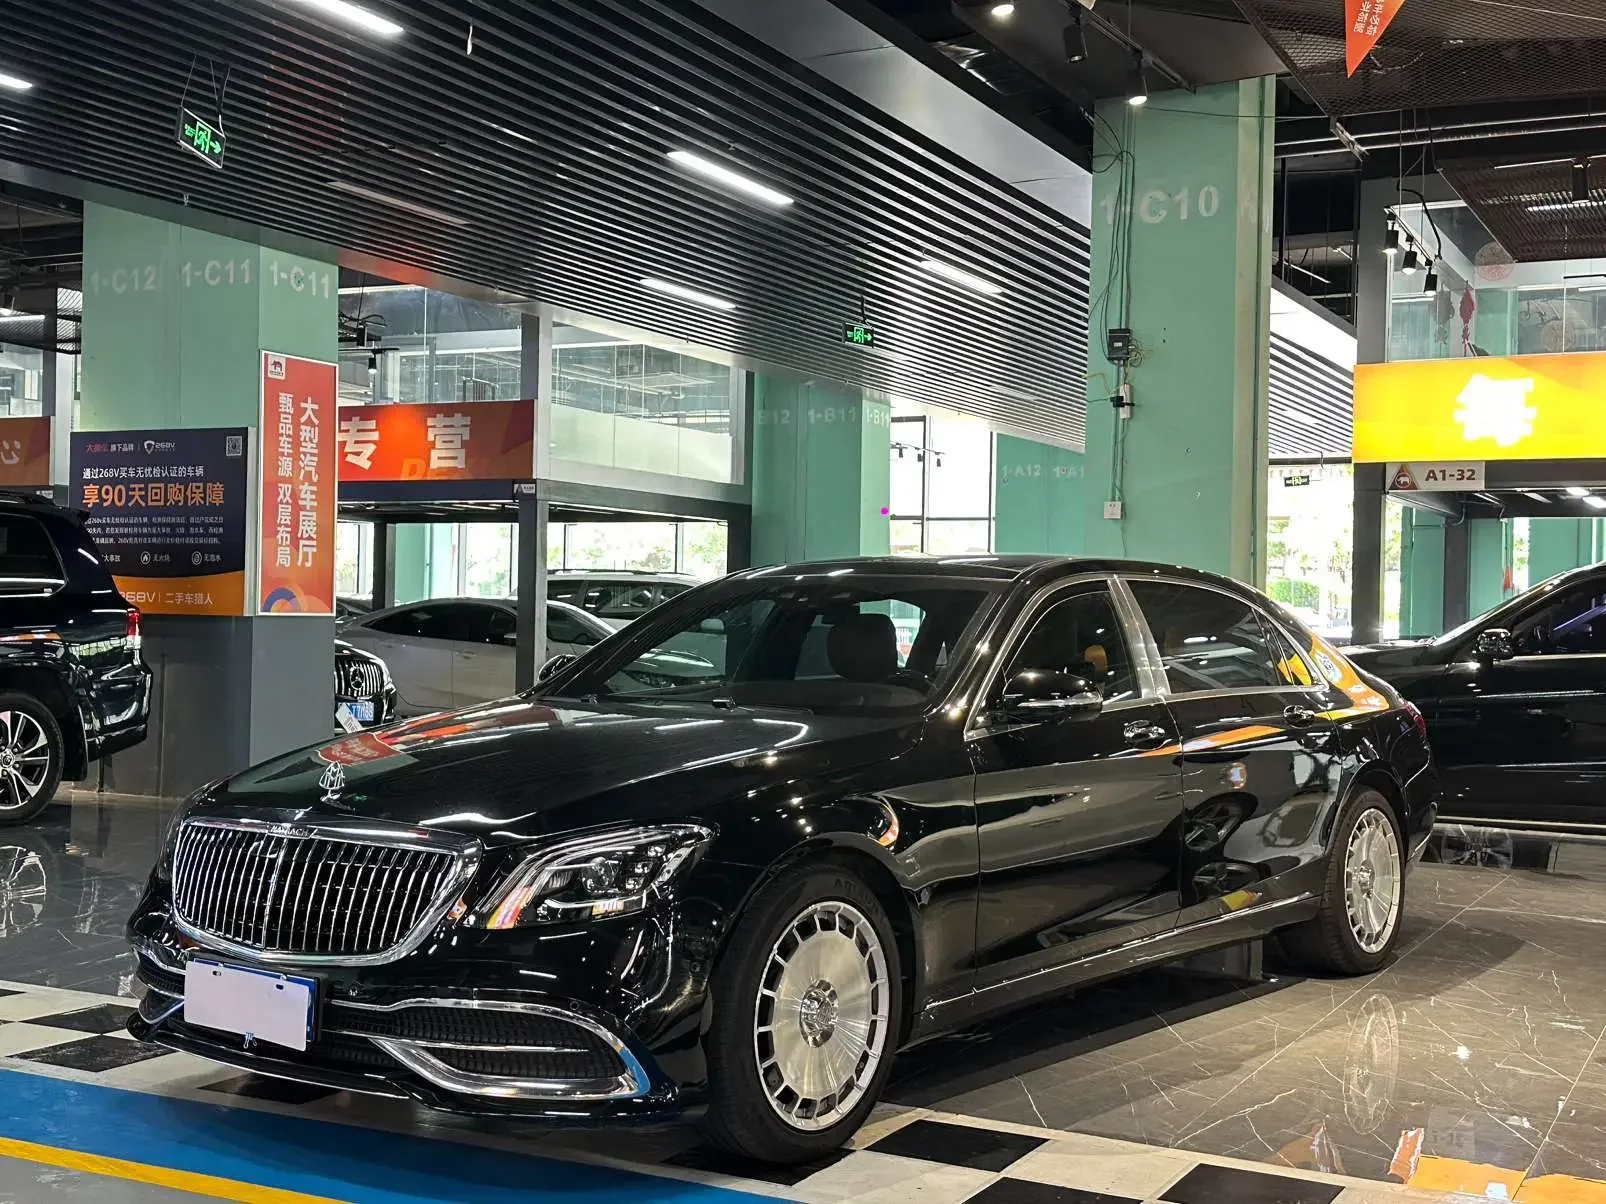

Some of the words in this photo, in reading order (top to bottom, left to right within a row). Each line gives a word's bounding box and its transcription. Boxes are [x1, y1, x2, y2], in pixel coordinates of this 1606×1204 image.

[91, 266, 157, 294] 1-C12
[181, 259, 251, 287] 1-C11
[269, 260, 329, 299] 1-C11
[277, 392, 294, 477] 甄品车源
[82, 465, 205, 480] 通过268V买车无忧检认证的车辆
[297, 396, 320, 568] 大型汽车展厅
[1425, 468, 1477, 482] A1-32
[82, 481, 225, 508] 享90天回购保障
[276, 483, 292, 568] 双层布局
